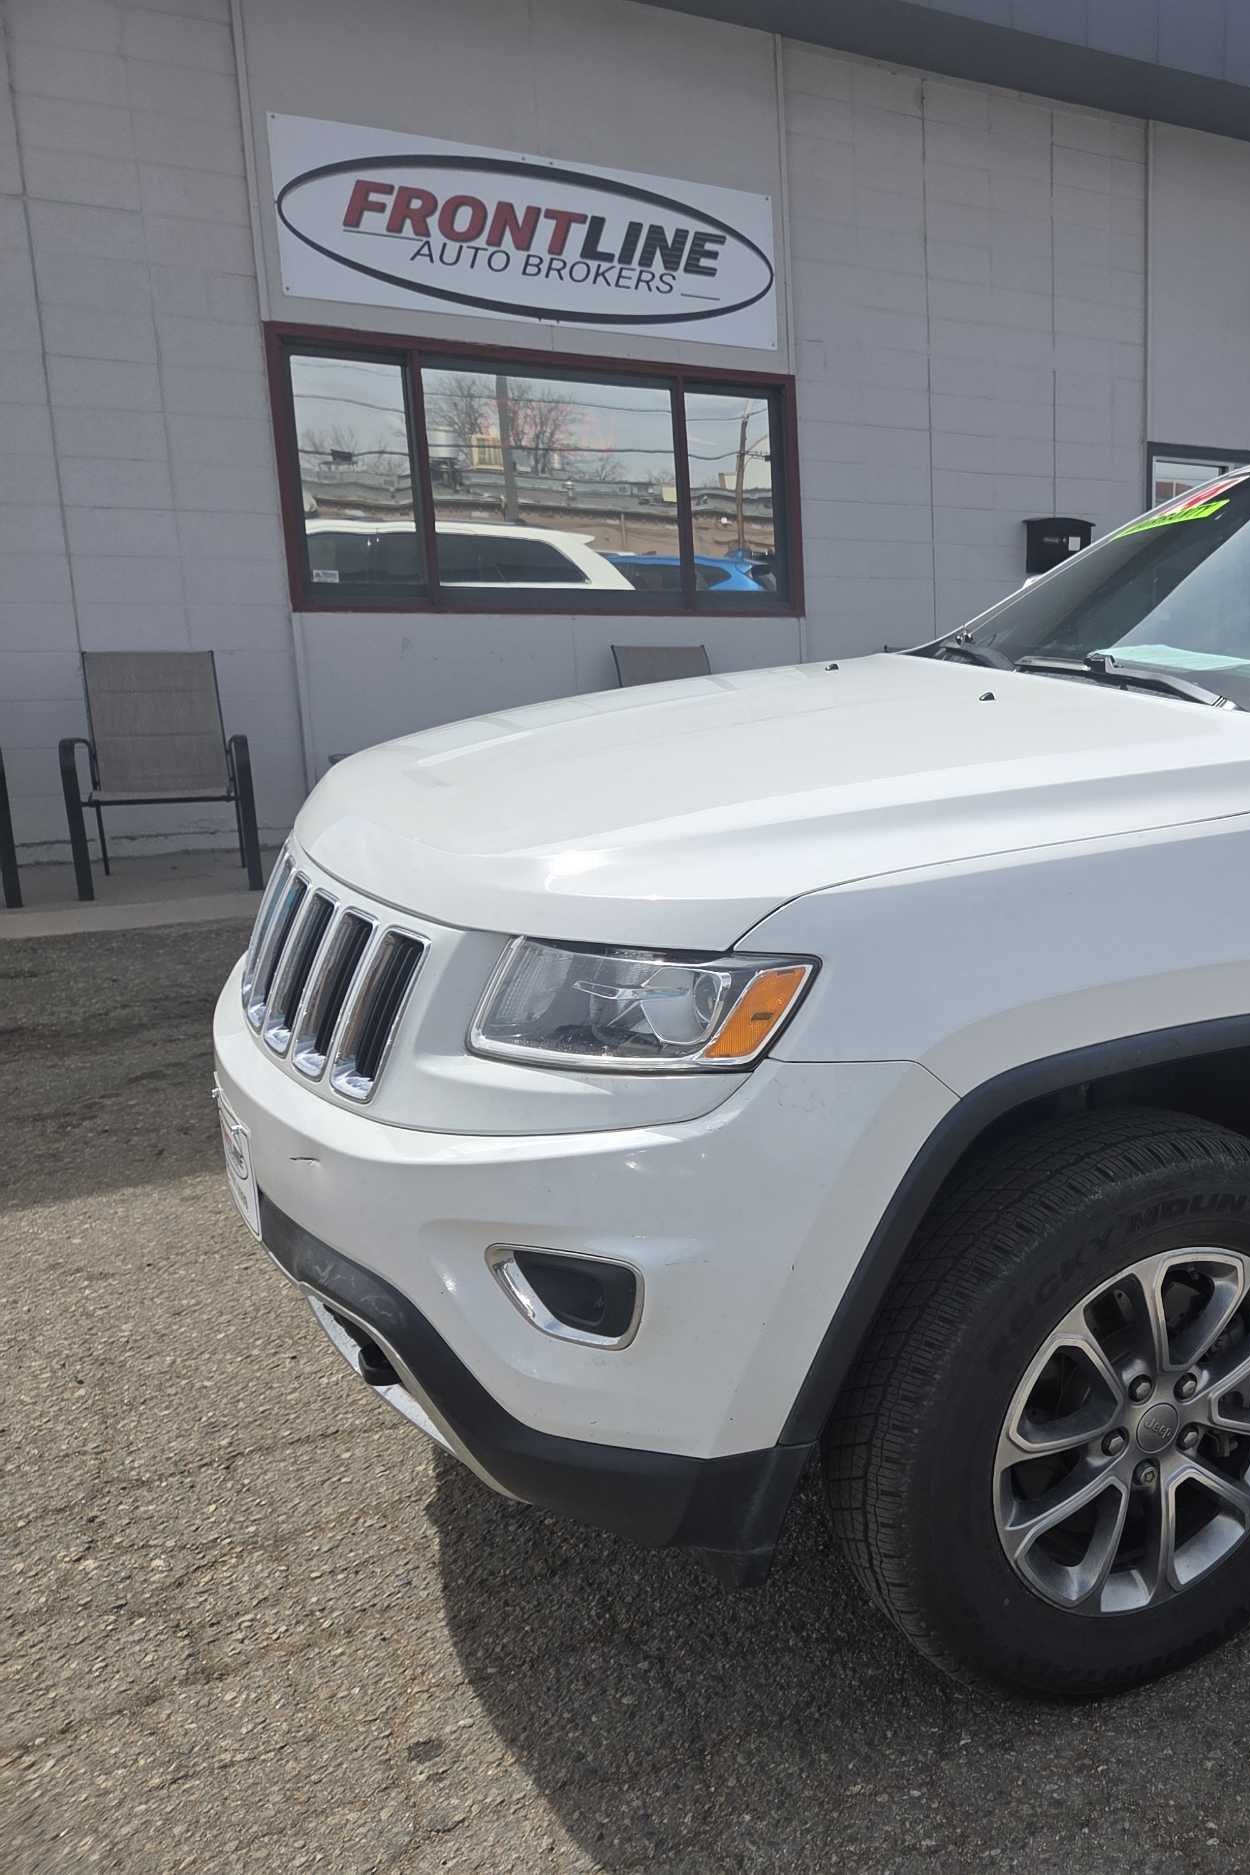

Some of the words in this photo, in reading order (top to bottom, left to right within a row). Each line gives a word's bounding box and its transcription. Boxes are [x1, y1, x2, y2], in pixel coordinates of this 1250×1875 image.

[342, 179, 728, 278] FRONTLINE
[410, 239, 511, 273] AUTO
[520, 253, 677, 295] BROKERS
[1144, 1417, 1172, 1440] Jeep
